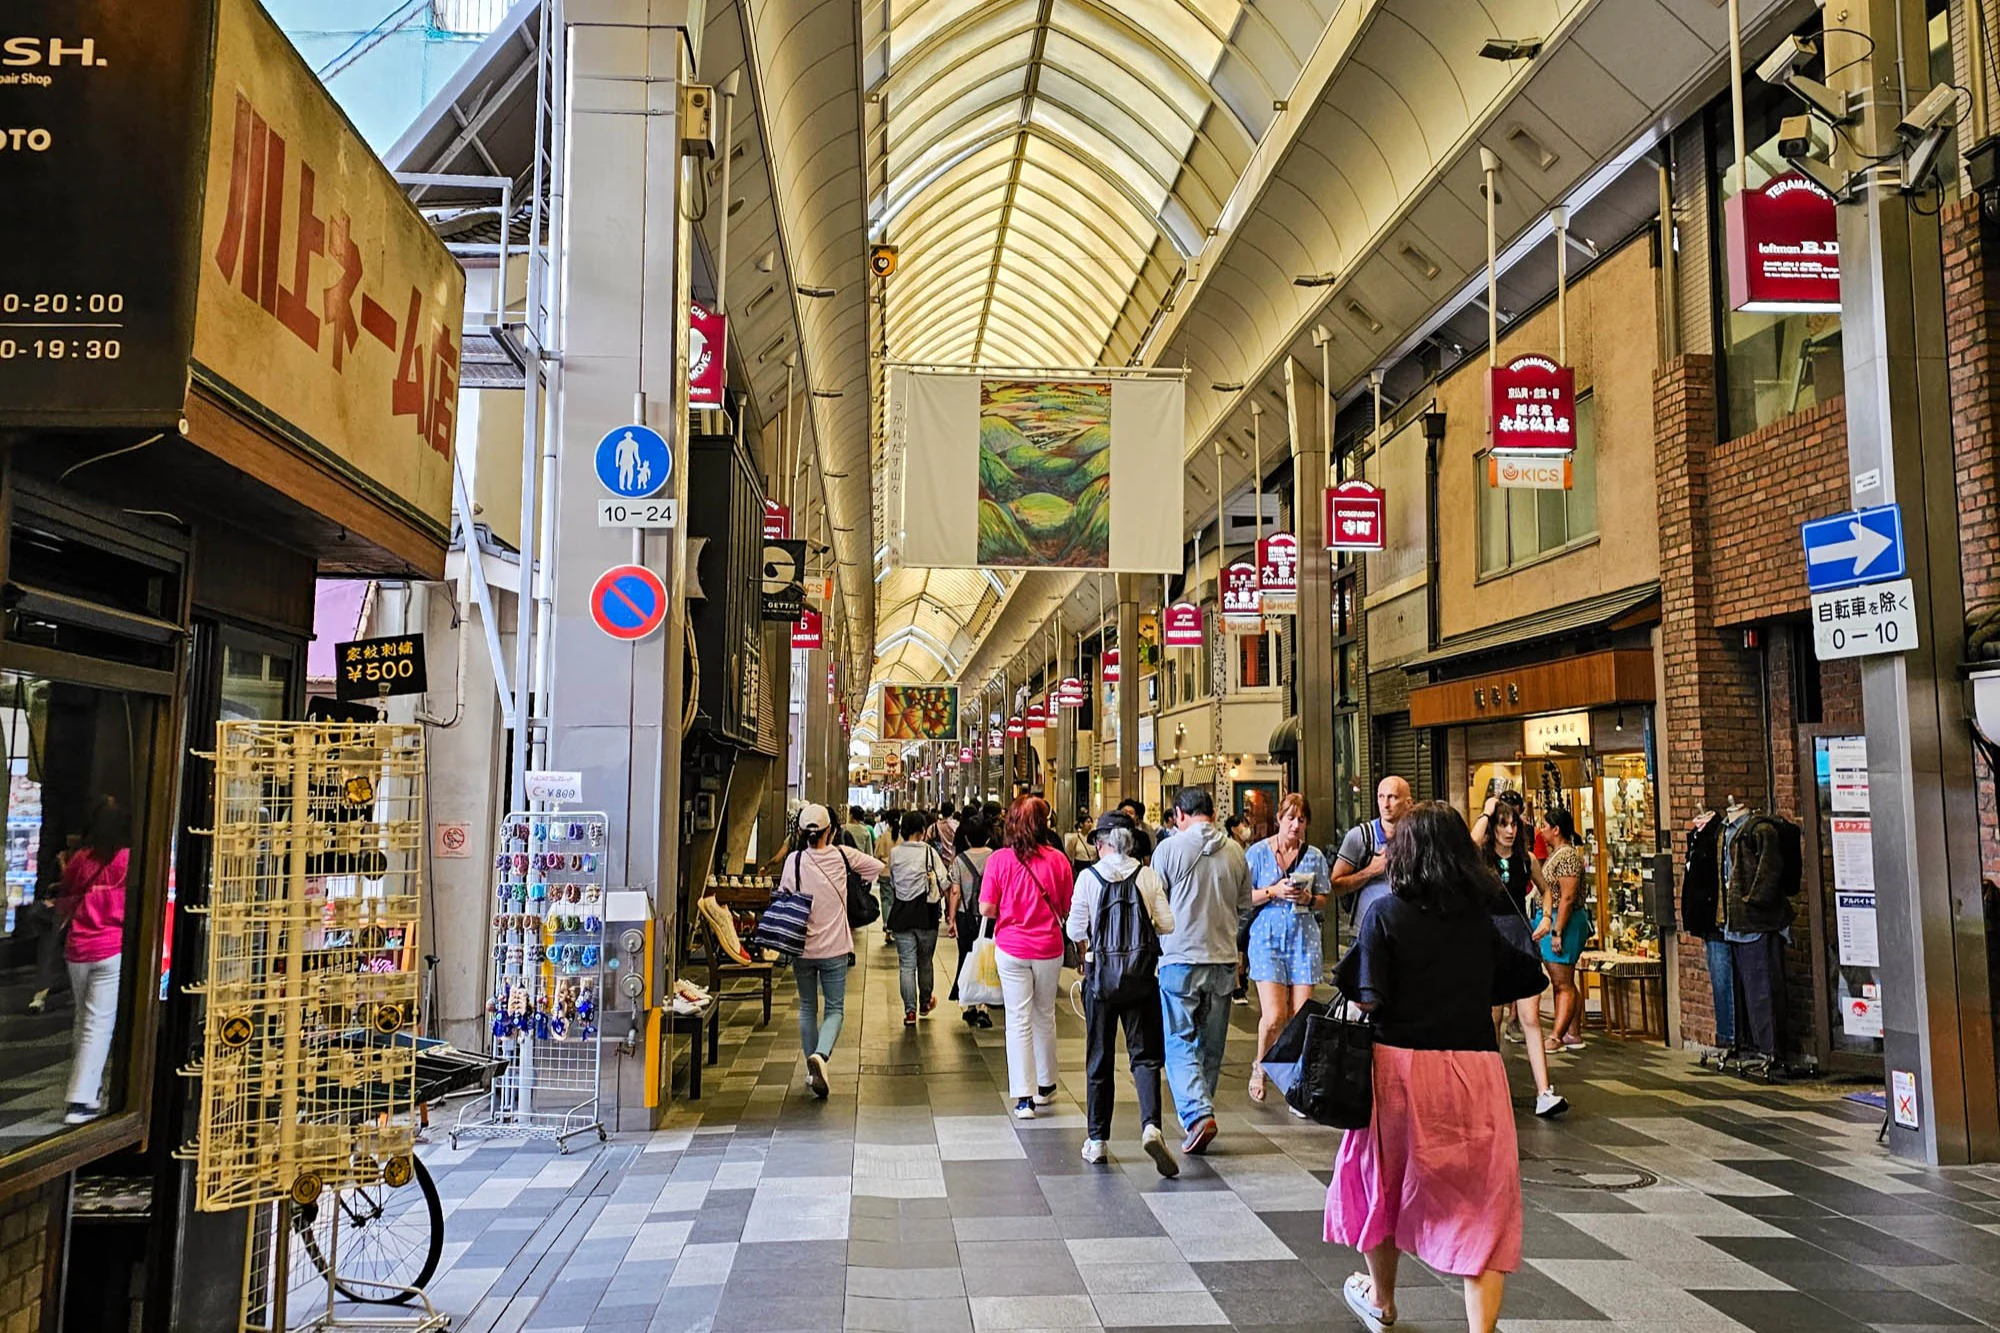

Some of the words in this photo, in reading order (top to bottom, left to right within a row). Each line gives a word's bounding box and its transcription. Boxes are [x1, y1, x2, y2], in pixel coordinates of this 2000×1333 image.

[21, 73, 52, 88] Shop
[0, 128, 52, 152] TO
[1759, 242, 1801, 254] loftman
[215, 88, 458, 461] 川上ネーム店
[1509, 357, 1557, 373] TERAMACHI
[1521, 468, 1559, 482] KICS
[1262, 577, 1297, 586] DAISHO
[1818, 591, 1909, 622] 自転車を除く
[346, 659, 414, 684] ¥500
